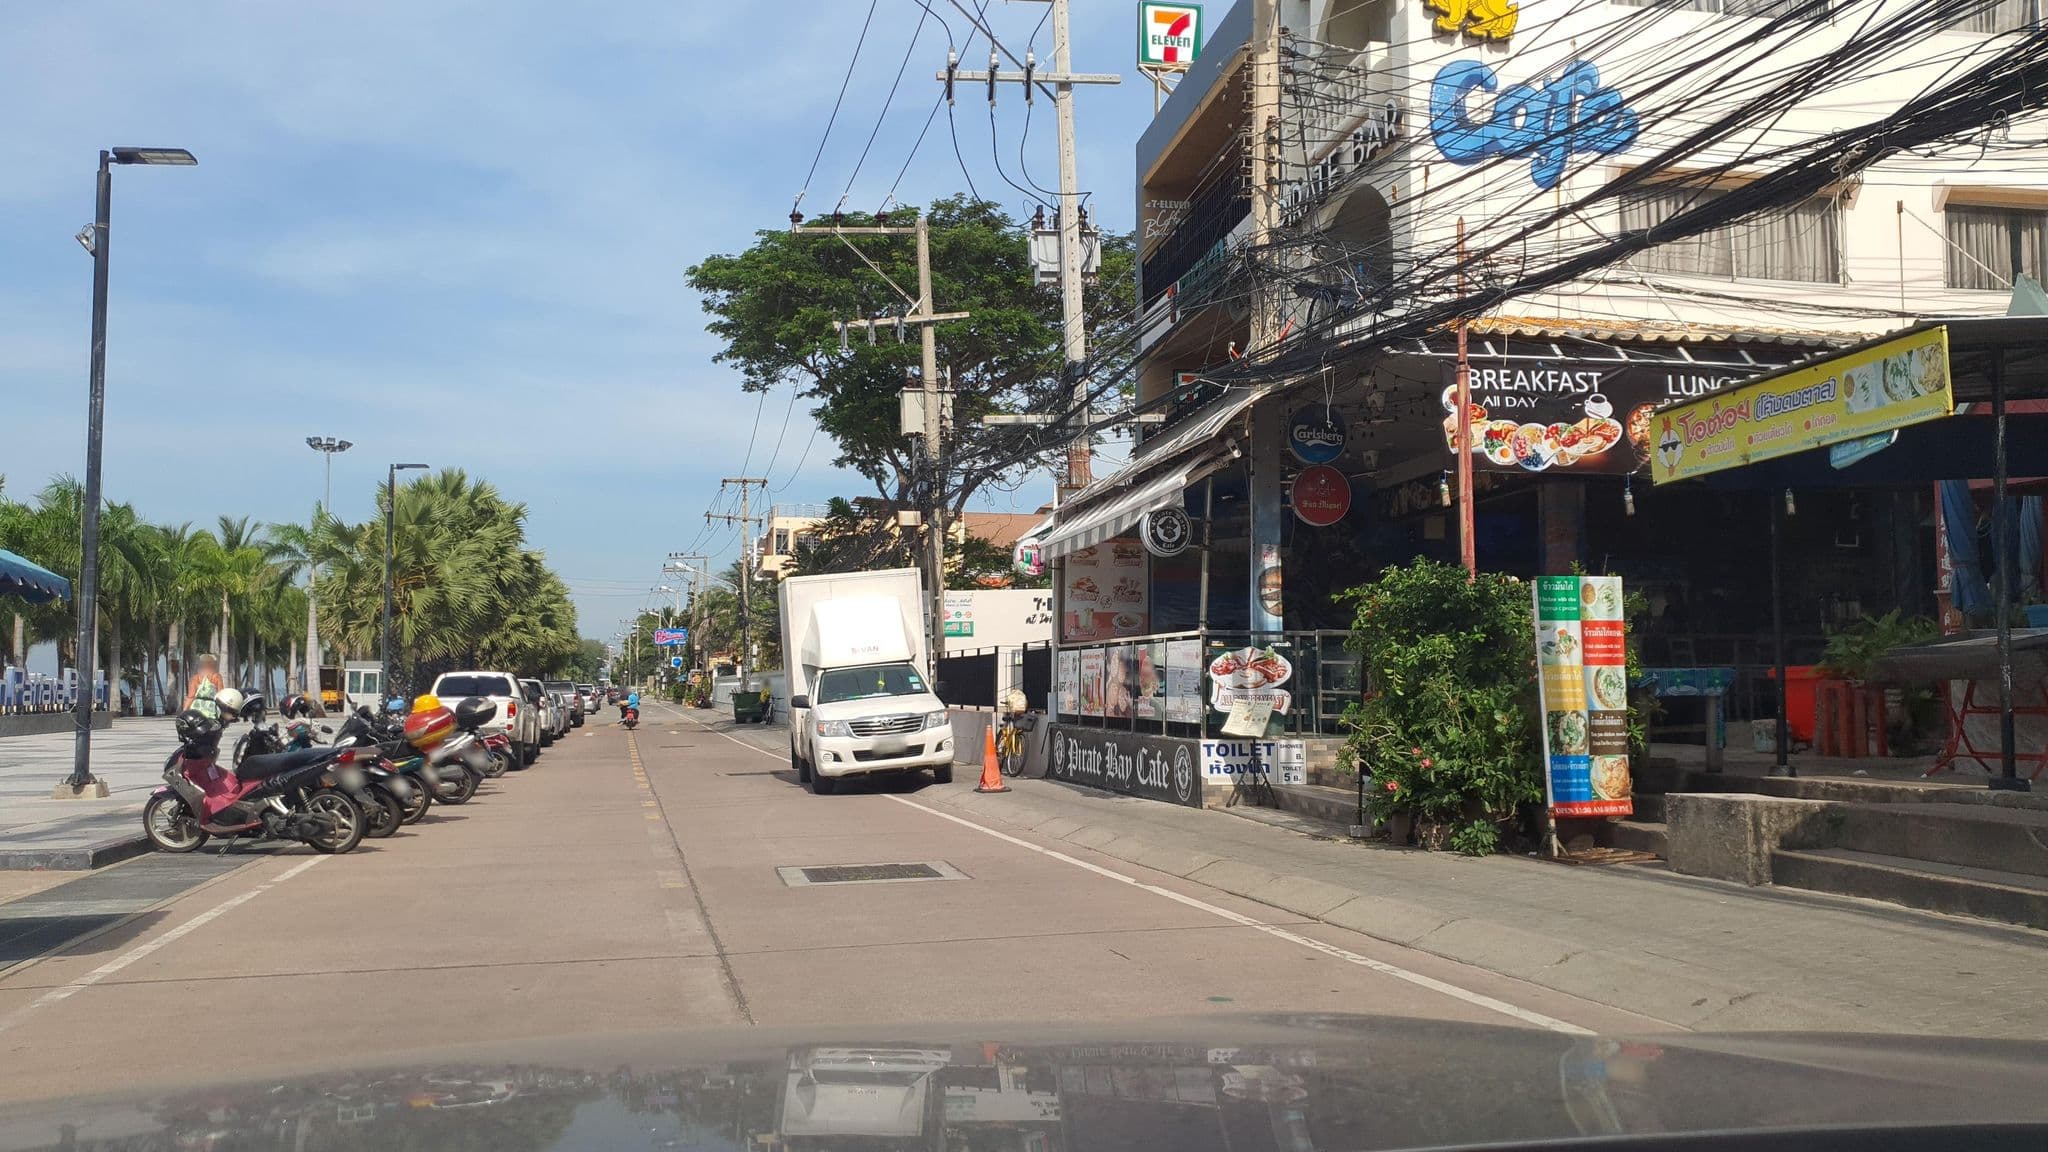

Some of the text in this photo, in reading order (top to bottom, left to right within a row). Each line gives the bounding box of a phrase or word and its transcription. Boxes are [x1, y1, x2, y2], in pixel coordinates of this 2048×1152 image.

[1470, 369, 1602, 392] BREAKFAST
[1668, 374, 1736, 395] LUNC
[1505, 396, 1538, 408] DAY
[1293, 424, 1344, 446] Carlsberg
[1203, 743, 1275, 757] TOILET
[1067, 738, 1102, 776] Pirate
[1105, 742, 1133, 789] Bay
[1137, 747, 1169, 789] Cafe
[1284, 773, 1290, 781] 5
